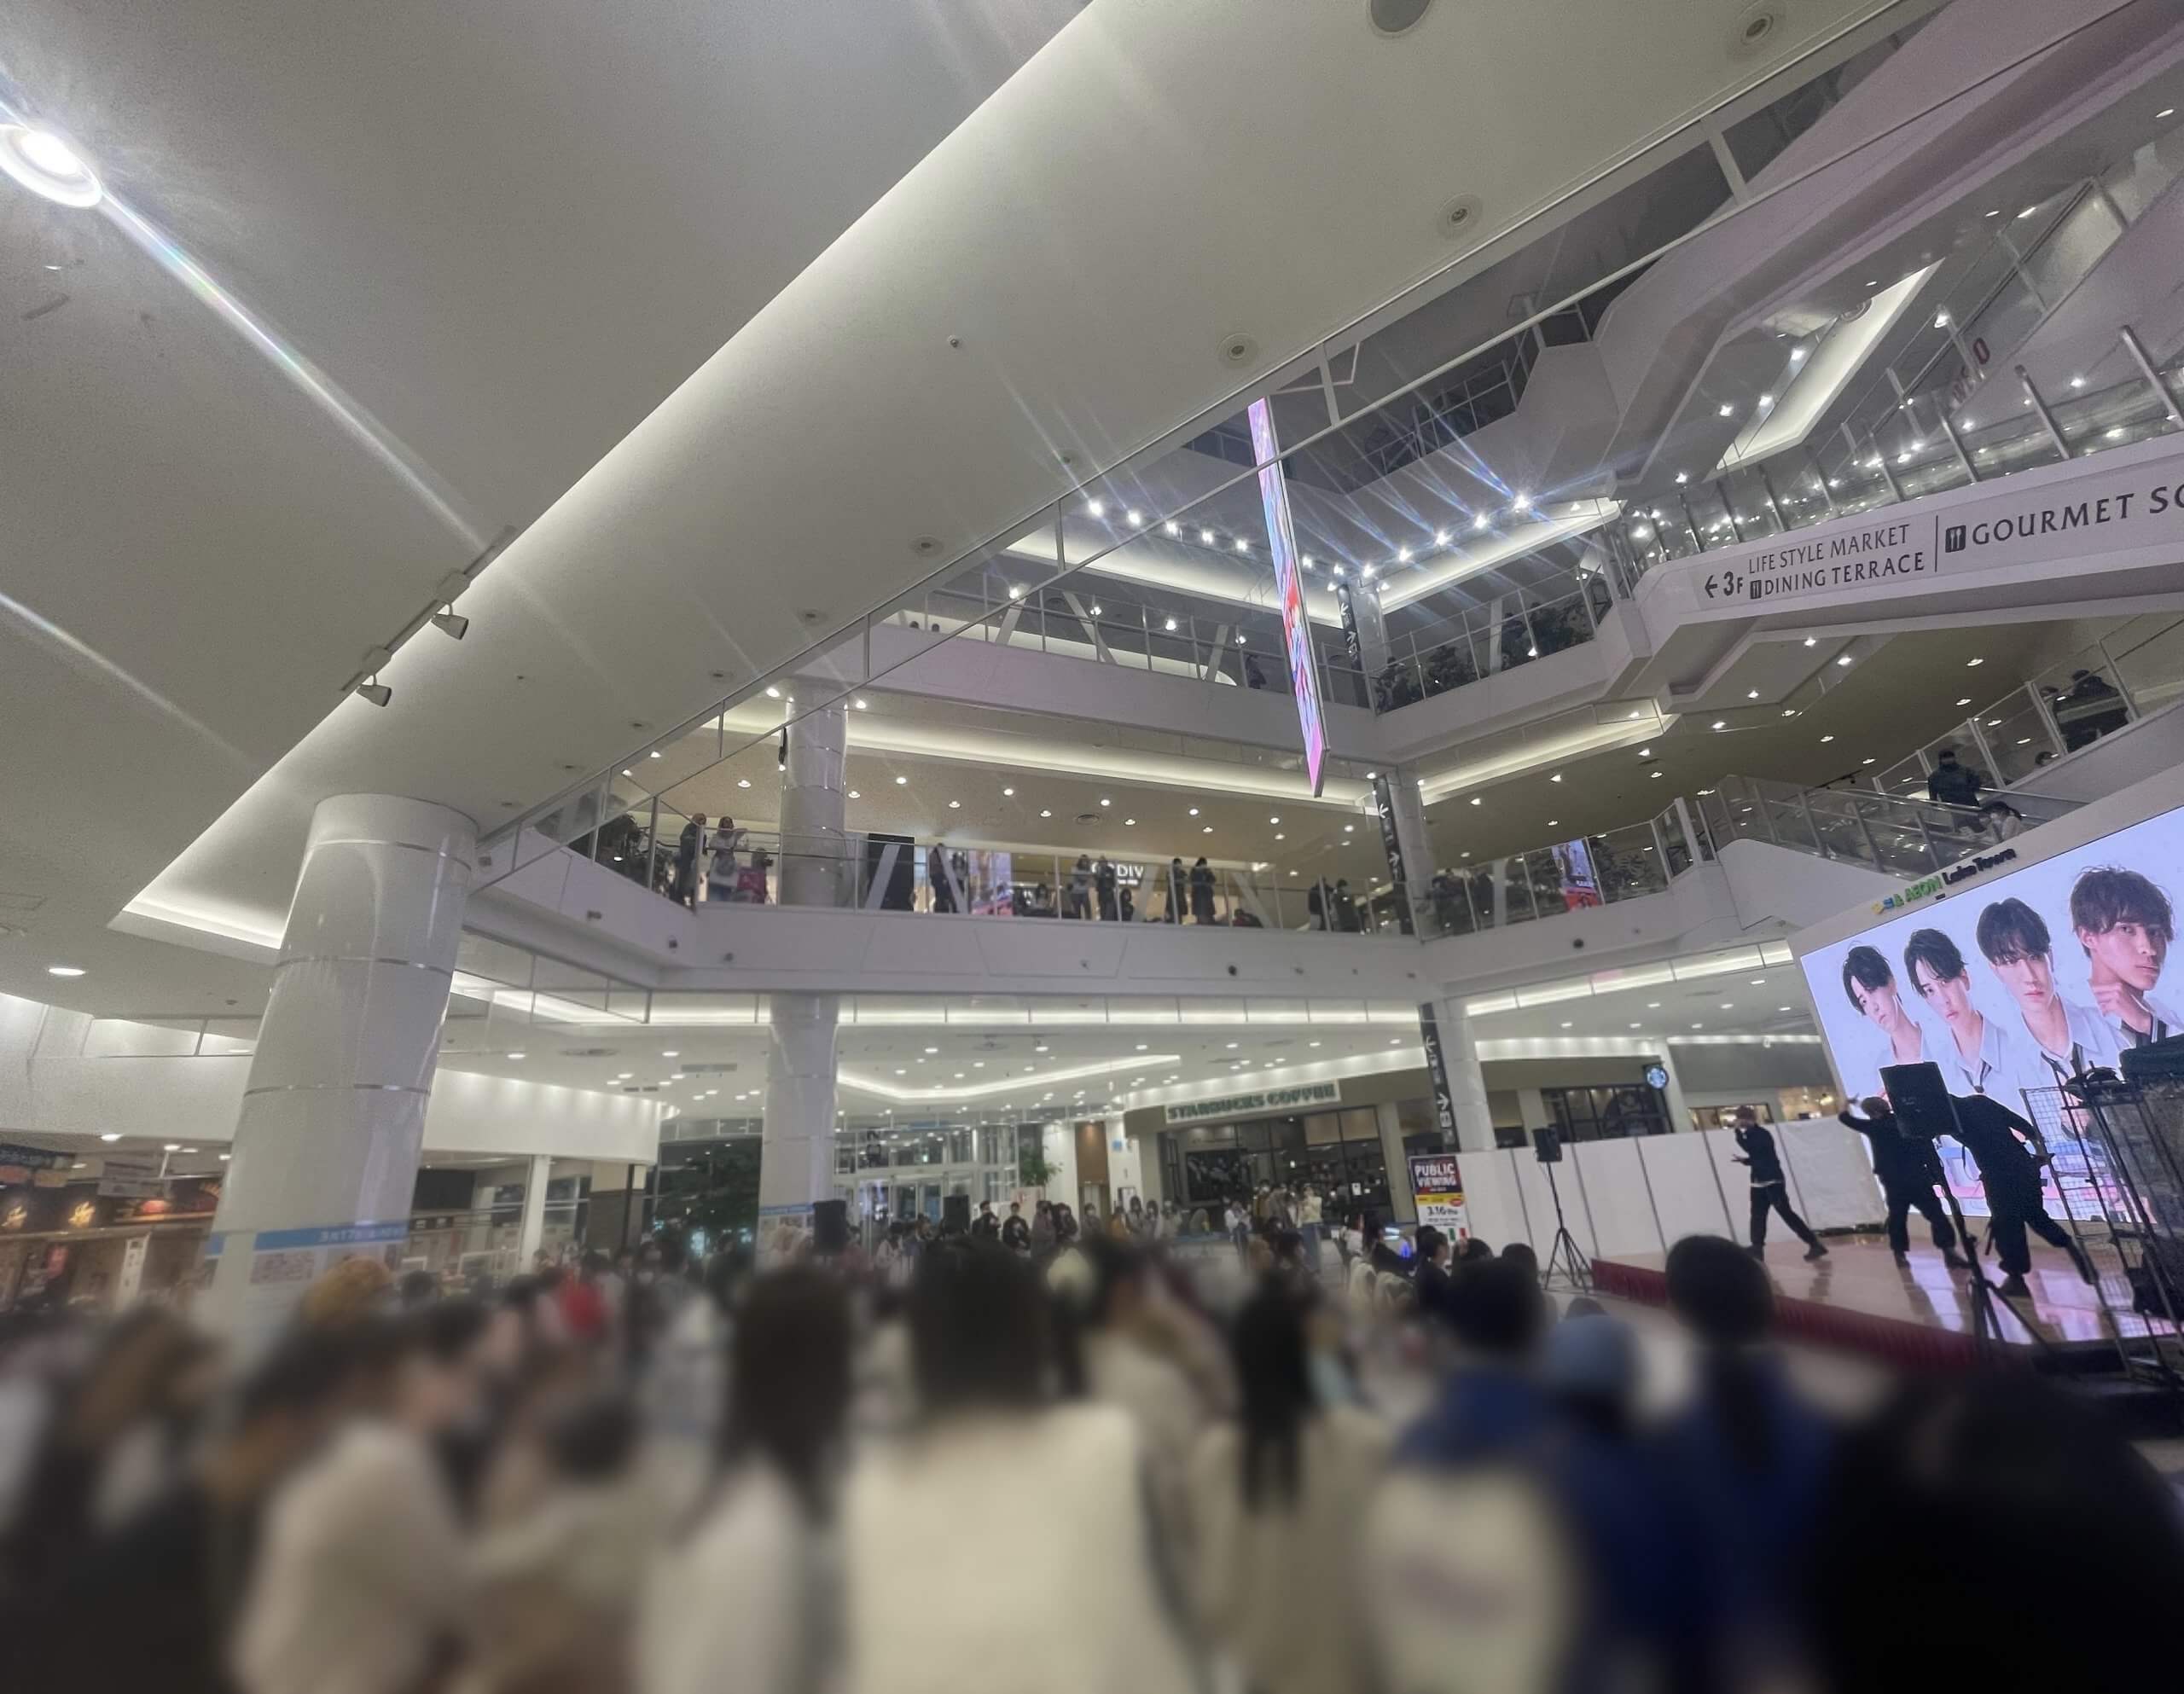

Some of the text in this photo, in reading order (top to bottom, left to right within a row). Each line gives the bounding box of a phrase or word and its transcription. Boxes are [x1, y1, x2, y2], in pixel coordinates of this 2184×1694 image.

[1972, 493, 2135, 544] GOURMET
[1749, 525, 1910, 574] LIFE STYLE MARKET
[1723, 571, 1743, 596] 3F
[1764, 552, 1926, 595] DINING TERRACE
[1168, 1094, 1264, 1119] STARBUCKS
[1414, 1163, 1455, 1176] PUBLIC
